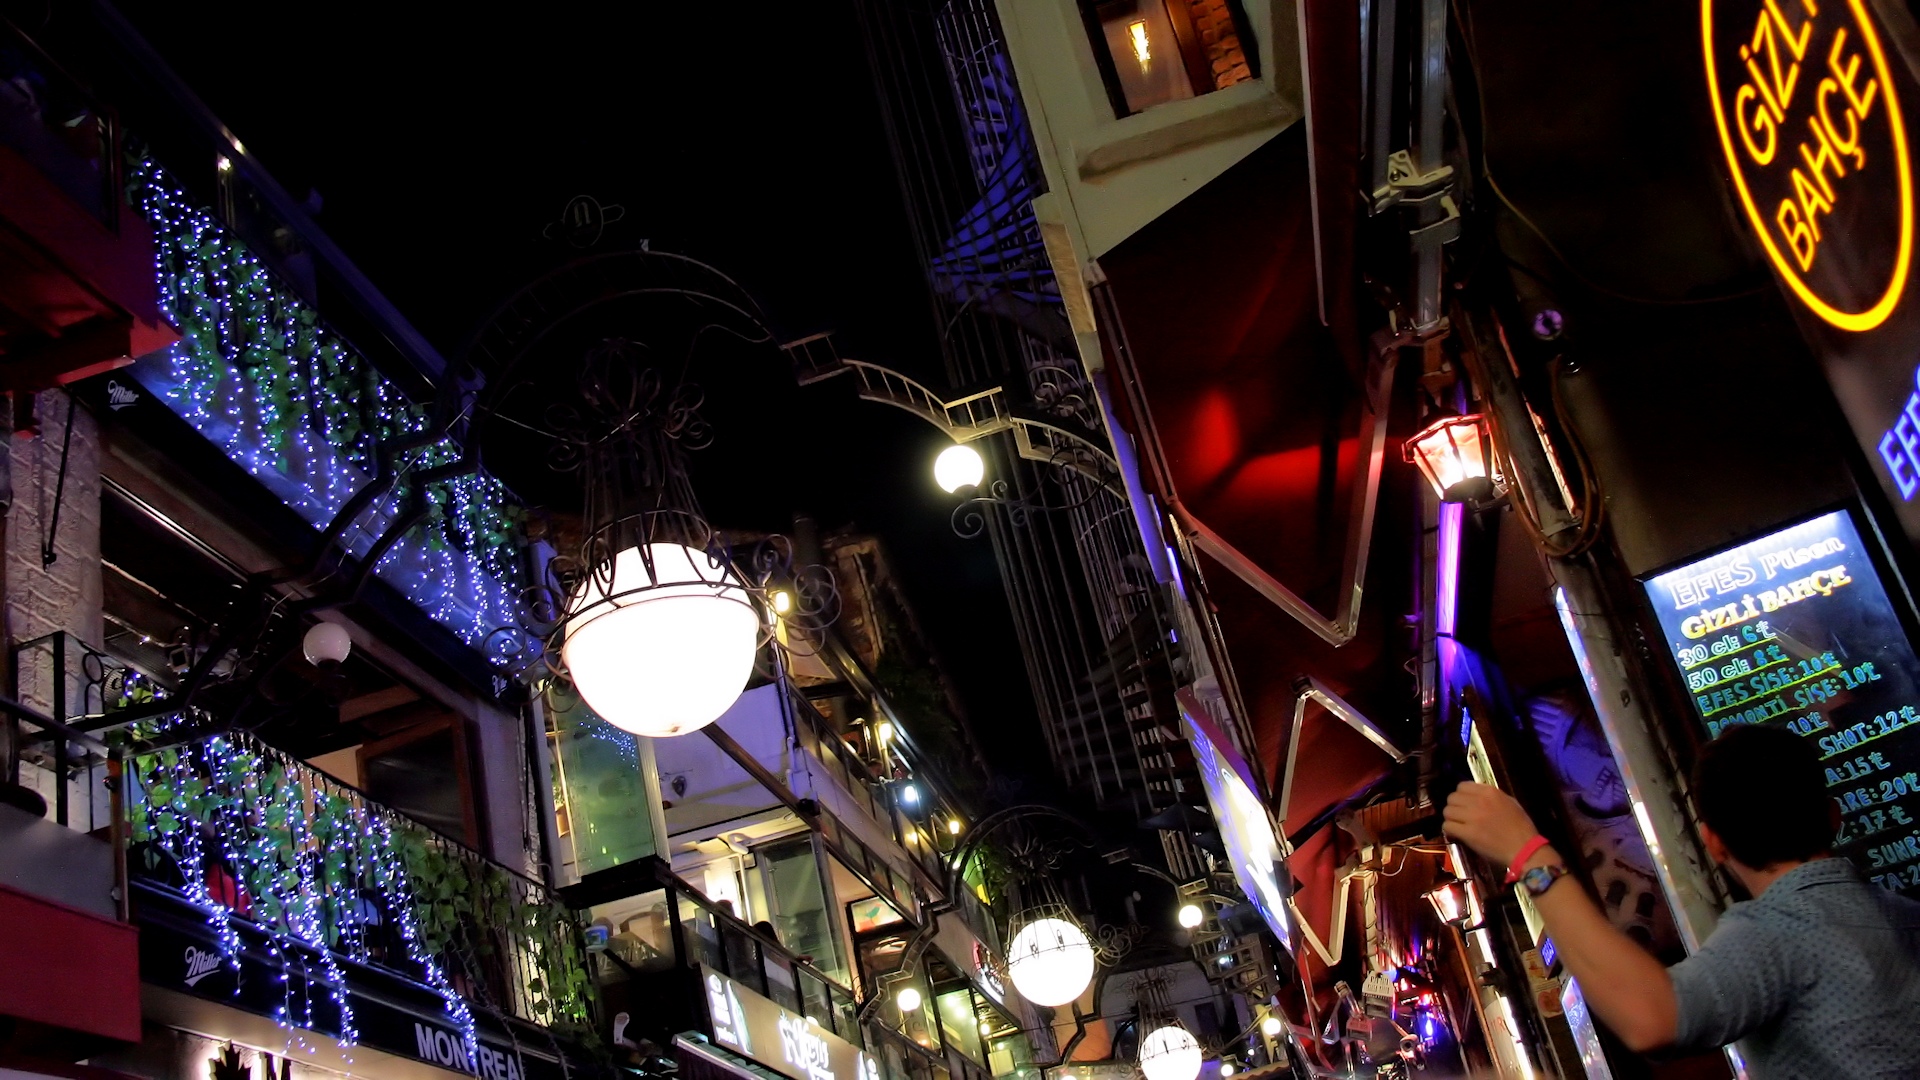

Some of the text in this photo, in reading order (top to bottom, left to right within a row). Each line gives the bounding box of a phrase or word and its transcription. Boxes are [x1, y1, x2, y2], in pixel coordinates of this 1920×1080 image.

[1736, 0, 1818, 165] GİZL
[1777, 27, 1877, 272] BAHÇE
[1667, 557, 1756, 610] EFES
[1681, 565, 1851, 639] GİZLİ BAHÇE
[1678, 644, 1708, 667] 30
[1711, 635, 1740, 656] cl:
[1687, 667, 1718, 690] 50
[1721, 658, 1751, 679] cl:
[1697, 682, 1749, 715] EFES
[185, 946, 222, 978] Miller
